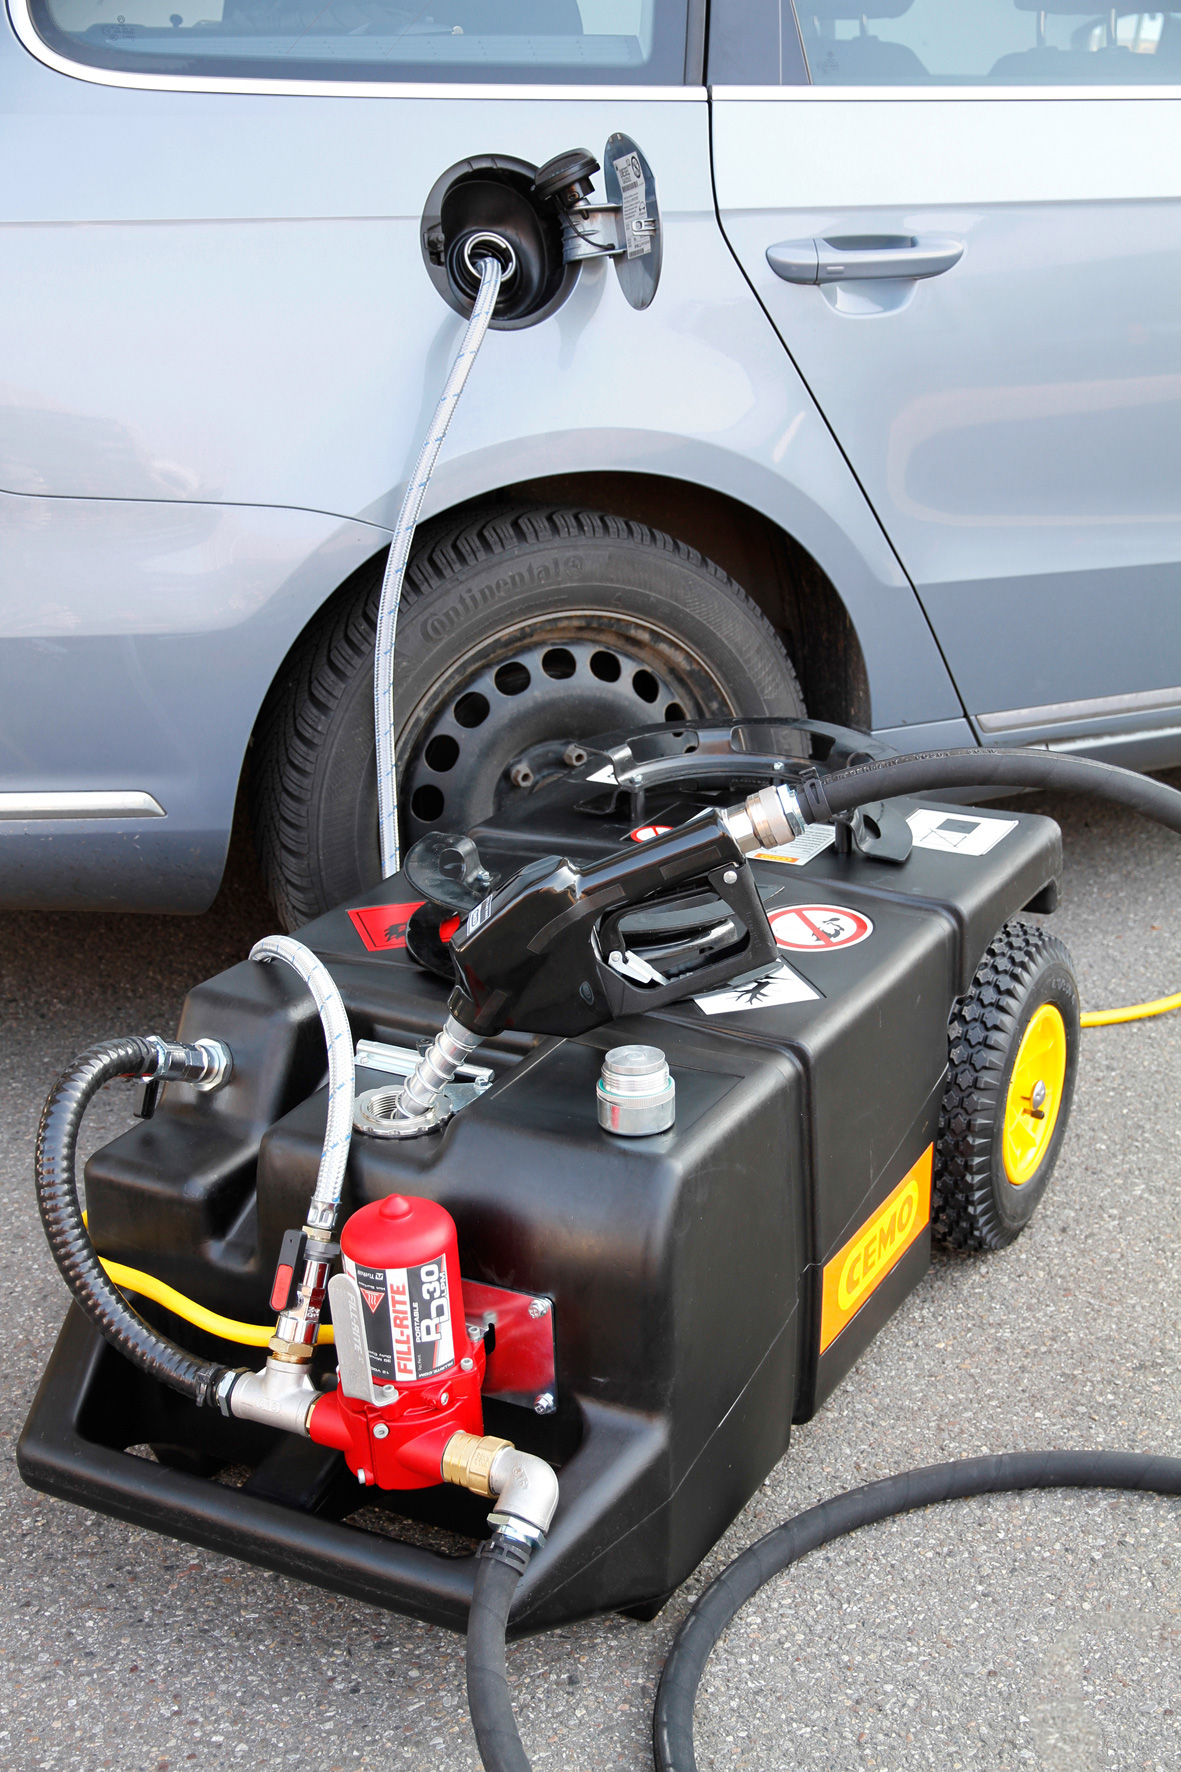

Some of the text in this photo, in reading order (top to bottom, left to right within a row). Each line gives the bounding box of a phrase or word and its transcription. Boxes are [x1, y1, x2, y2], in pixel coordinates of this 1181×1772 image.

[420, 555, 561, 645] Continental
[846, 1194, 914, 1295] CEMO
[439, 1271, 448, 1297] LPM
[347, 1291, 363, 1354] FILL-RITE
[389, 1283, 414, 1375] FILL-RITE
[413, 1302, 422, 1343] PORTABLE
